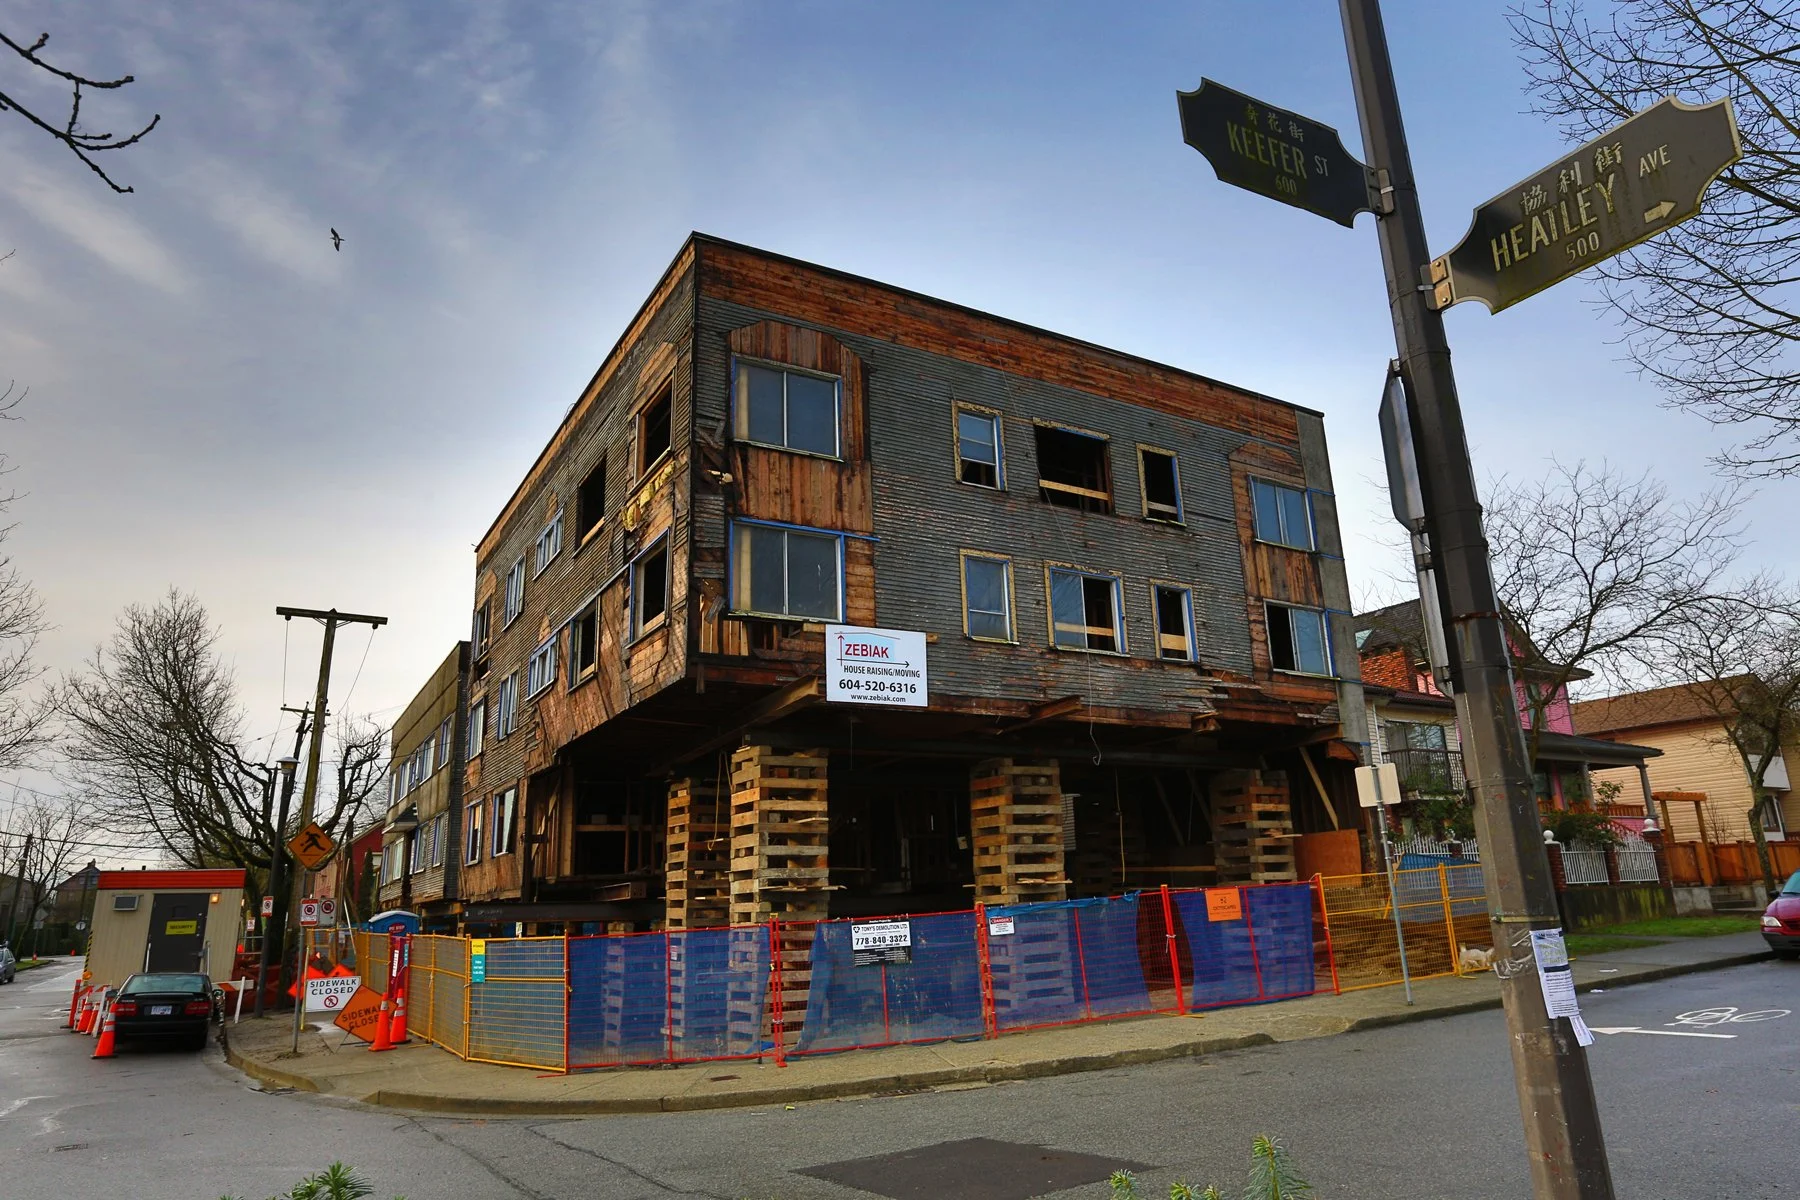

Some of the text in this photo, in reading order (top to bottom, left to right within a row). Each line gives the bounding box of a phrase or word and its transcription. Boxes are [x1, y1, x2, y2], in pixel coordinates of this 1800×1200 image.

[1227, 121, 1328, 179] KEEFER ST
[1275, 175, 1297, 196] 600
[1491, 144, 1671, 272] HEATLEY AVE
[1566, 231, 1600, 263] 500
[845, 644, 889, 658] ZEBIAK
[844, 665, 920, 678] HOUSE RAISING/MOVING
[839, 679, 917, 694] 604-520-6316
[851, 694, 906, 702] www.zebiak.com
[855, 934, 908, 946] 778-840-3322
[310, 978, 357, 988] SIDEWALK
[311, 986, 354, 996] CLOSED
[342, 1004, 381, 1022] SIDEWAL
[349, 1014, 380, 1029] CLOSE
